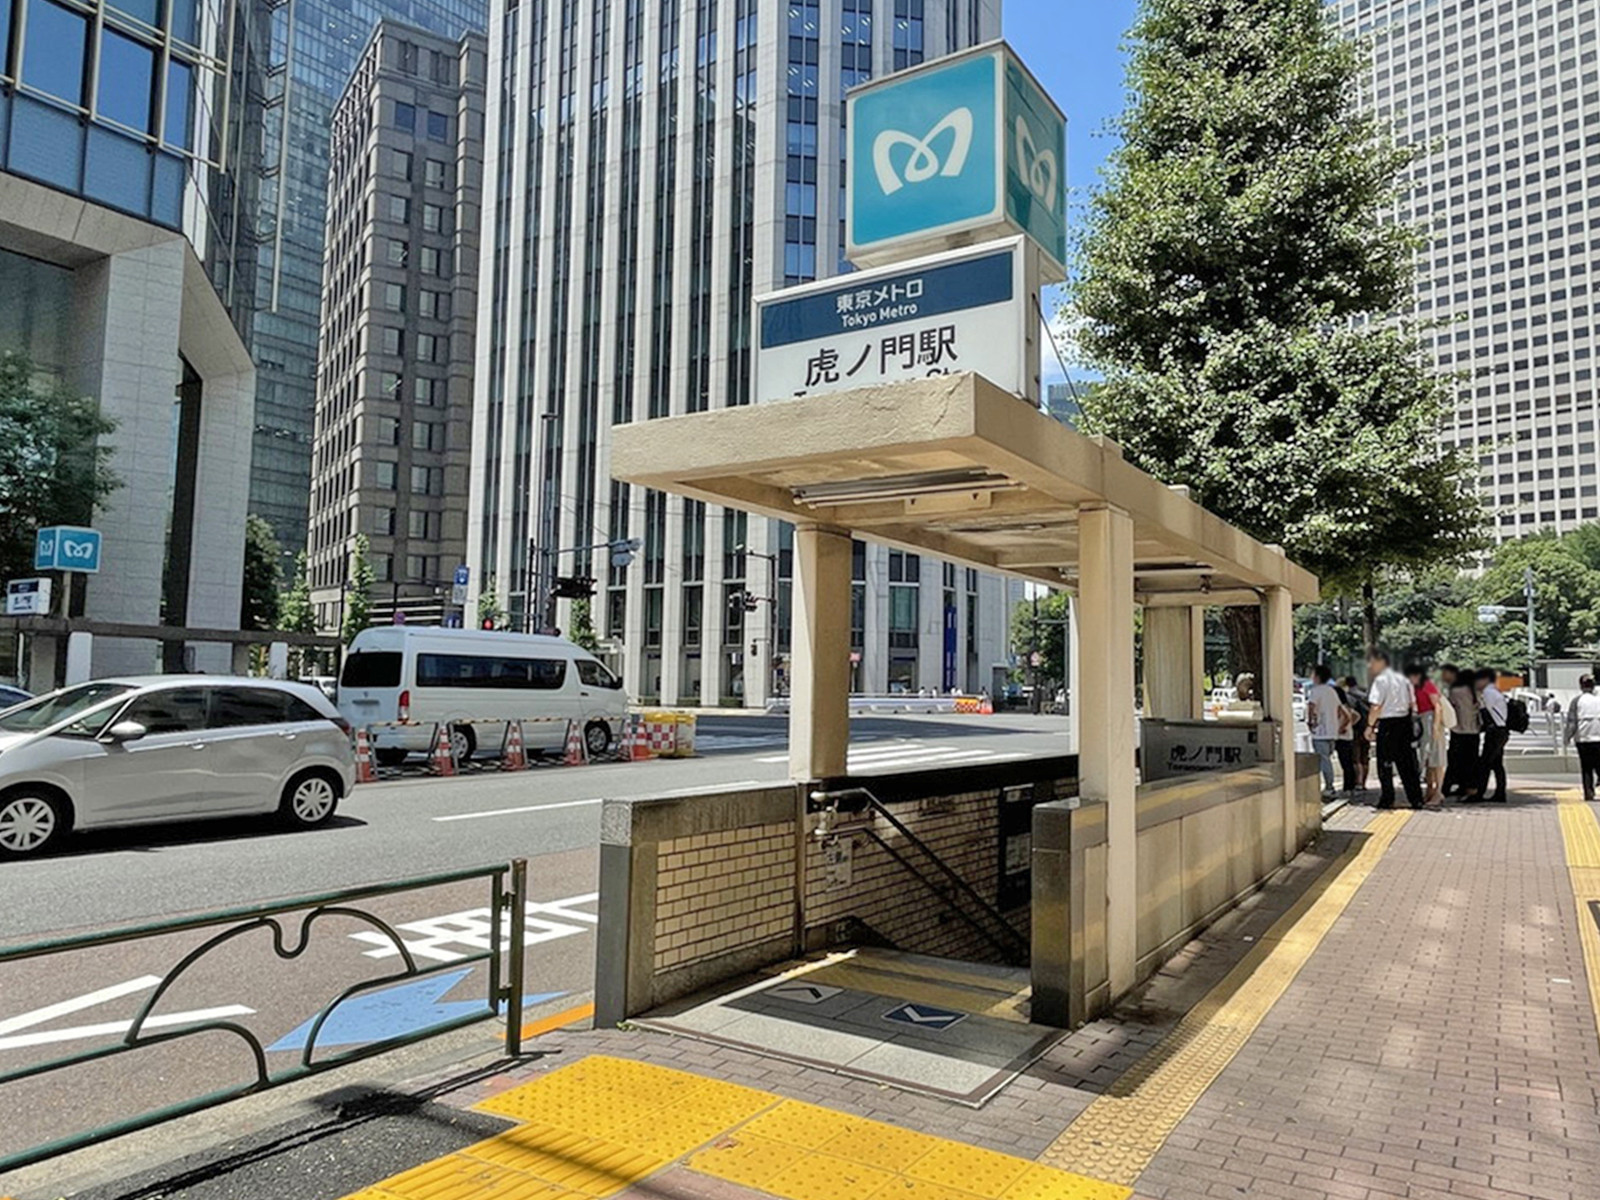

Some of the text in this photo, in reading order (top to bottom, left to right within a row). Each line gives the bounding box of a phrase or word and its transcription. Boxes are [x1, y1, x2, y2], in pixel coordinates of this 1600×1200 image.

[837, 279, 923, 313] 東京メトロ
[841, 303, 918, 328] Tokyo Metro
[805, 324, 958, 387] 虎ノ門駅
[1170, 744, 1242, 763] 虎ノ門駅
